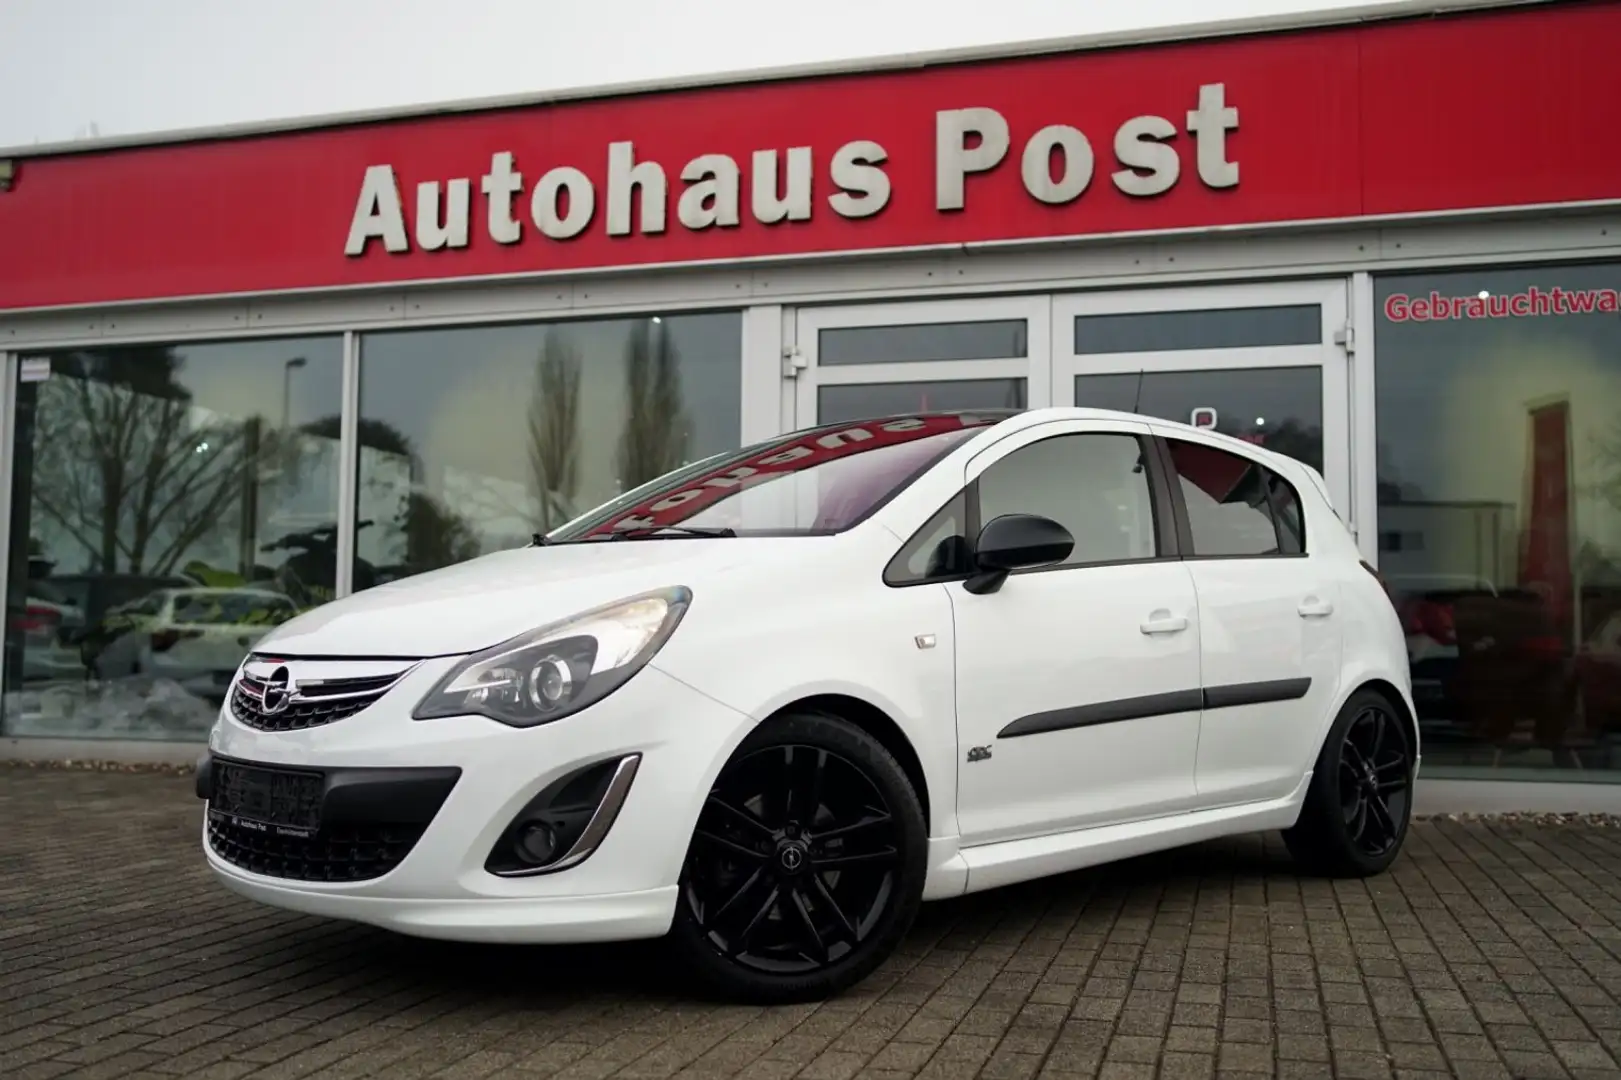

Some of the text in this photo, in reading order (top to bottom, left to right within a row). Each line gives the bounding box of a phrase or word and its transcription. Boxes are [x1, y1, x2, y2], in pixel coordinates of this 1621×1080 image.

[344, 82, 1240, 255] Autohaus Post
[1384, 286, 1621, 323] Gebrauchtwa
